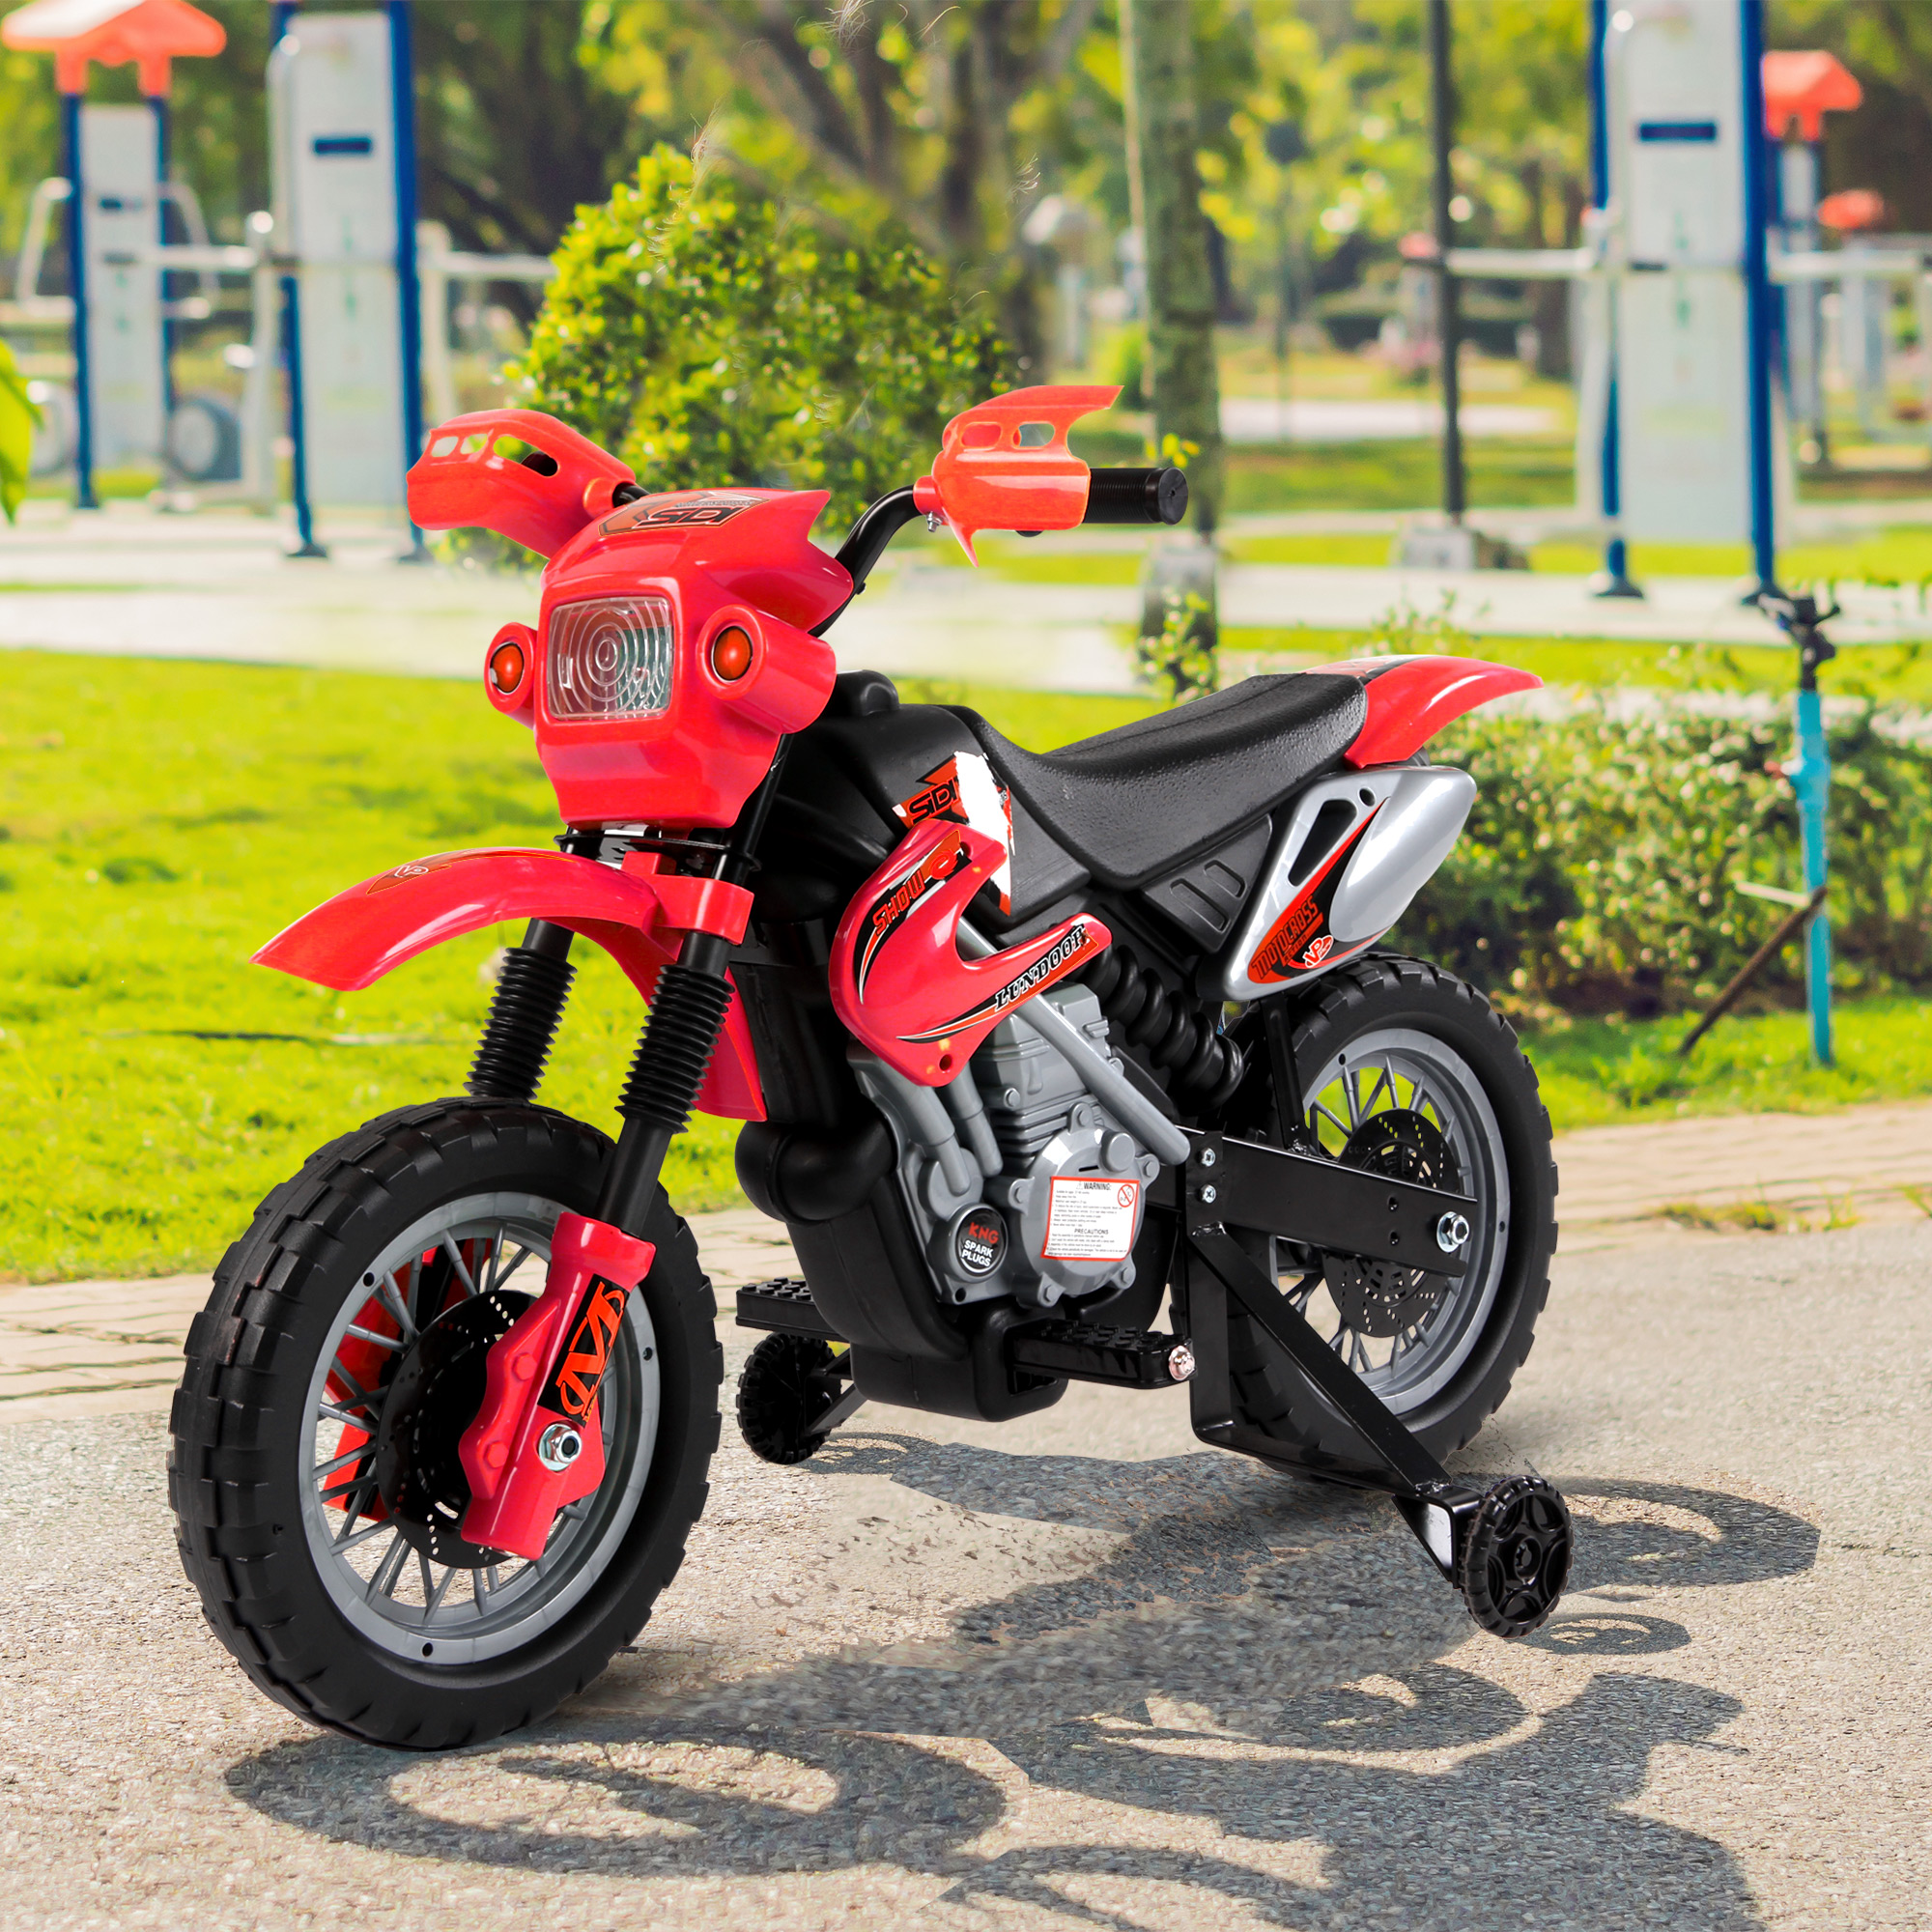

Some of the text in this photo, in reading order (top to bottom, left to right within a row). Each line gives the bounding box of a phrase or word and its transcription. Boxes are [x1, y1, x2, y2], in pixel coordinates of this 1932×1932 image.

[872, 869, 925, 936] SHOW
[1251, 895, 1319, 980] MOTOCROSS
[1303, 937, 1323, 965] VP
[969, 1222, 999, 1244] KNG
[961, 1249, 991, 1267] PLUGS
[964, 1239, 994, 1258] SPARK
